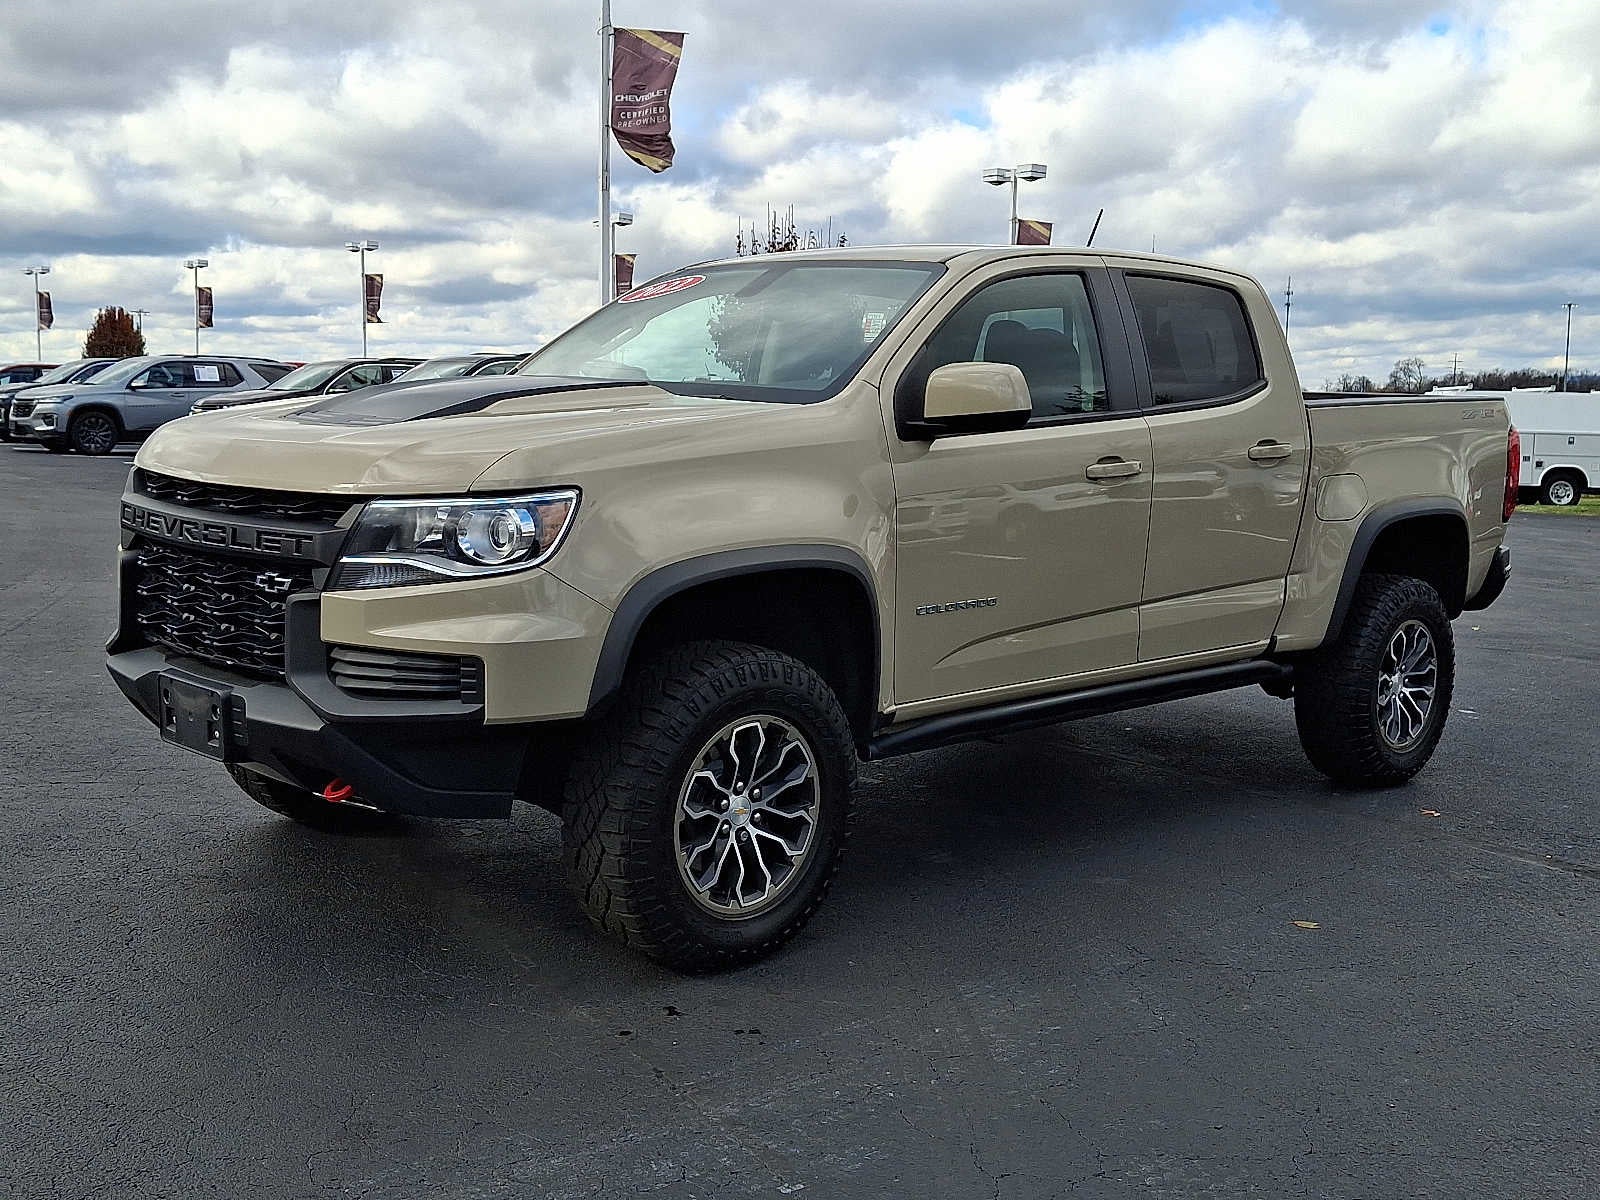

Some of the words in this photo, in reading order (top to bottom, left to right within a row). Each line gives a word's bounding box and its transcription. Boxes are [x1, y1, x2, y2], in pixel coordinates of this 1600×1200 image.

[615, 88, 668, 101] CHEVROLET
[620, 106, 665, 119] CERTIFIED
[617, 115, 667, 128] PRE-OWNED
[121, 504, 314, 556] CHEVROLET
[916, 597, 997, 615] COLORADO
